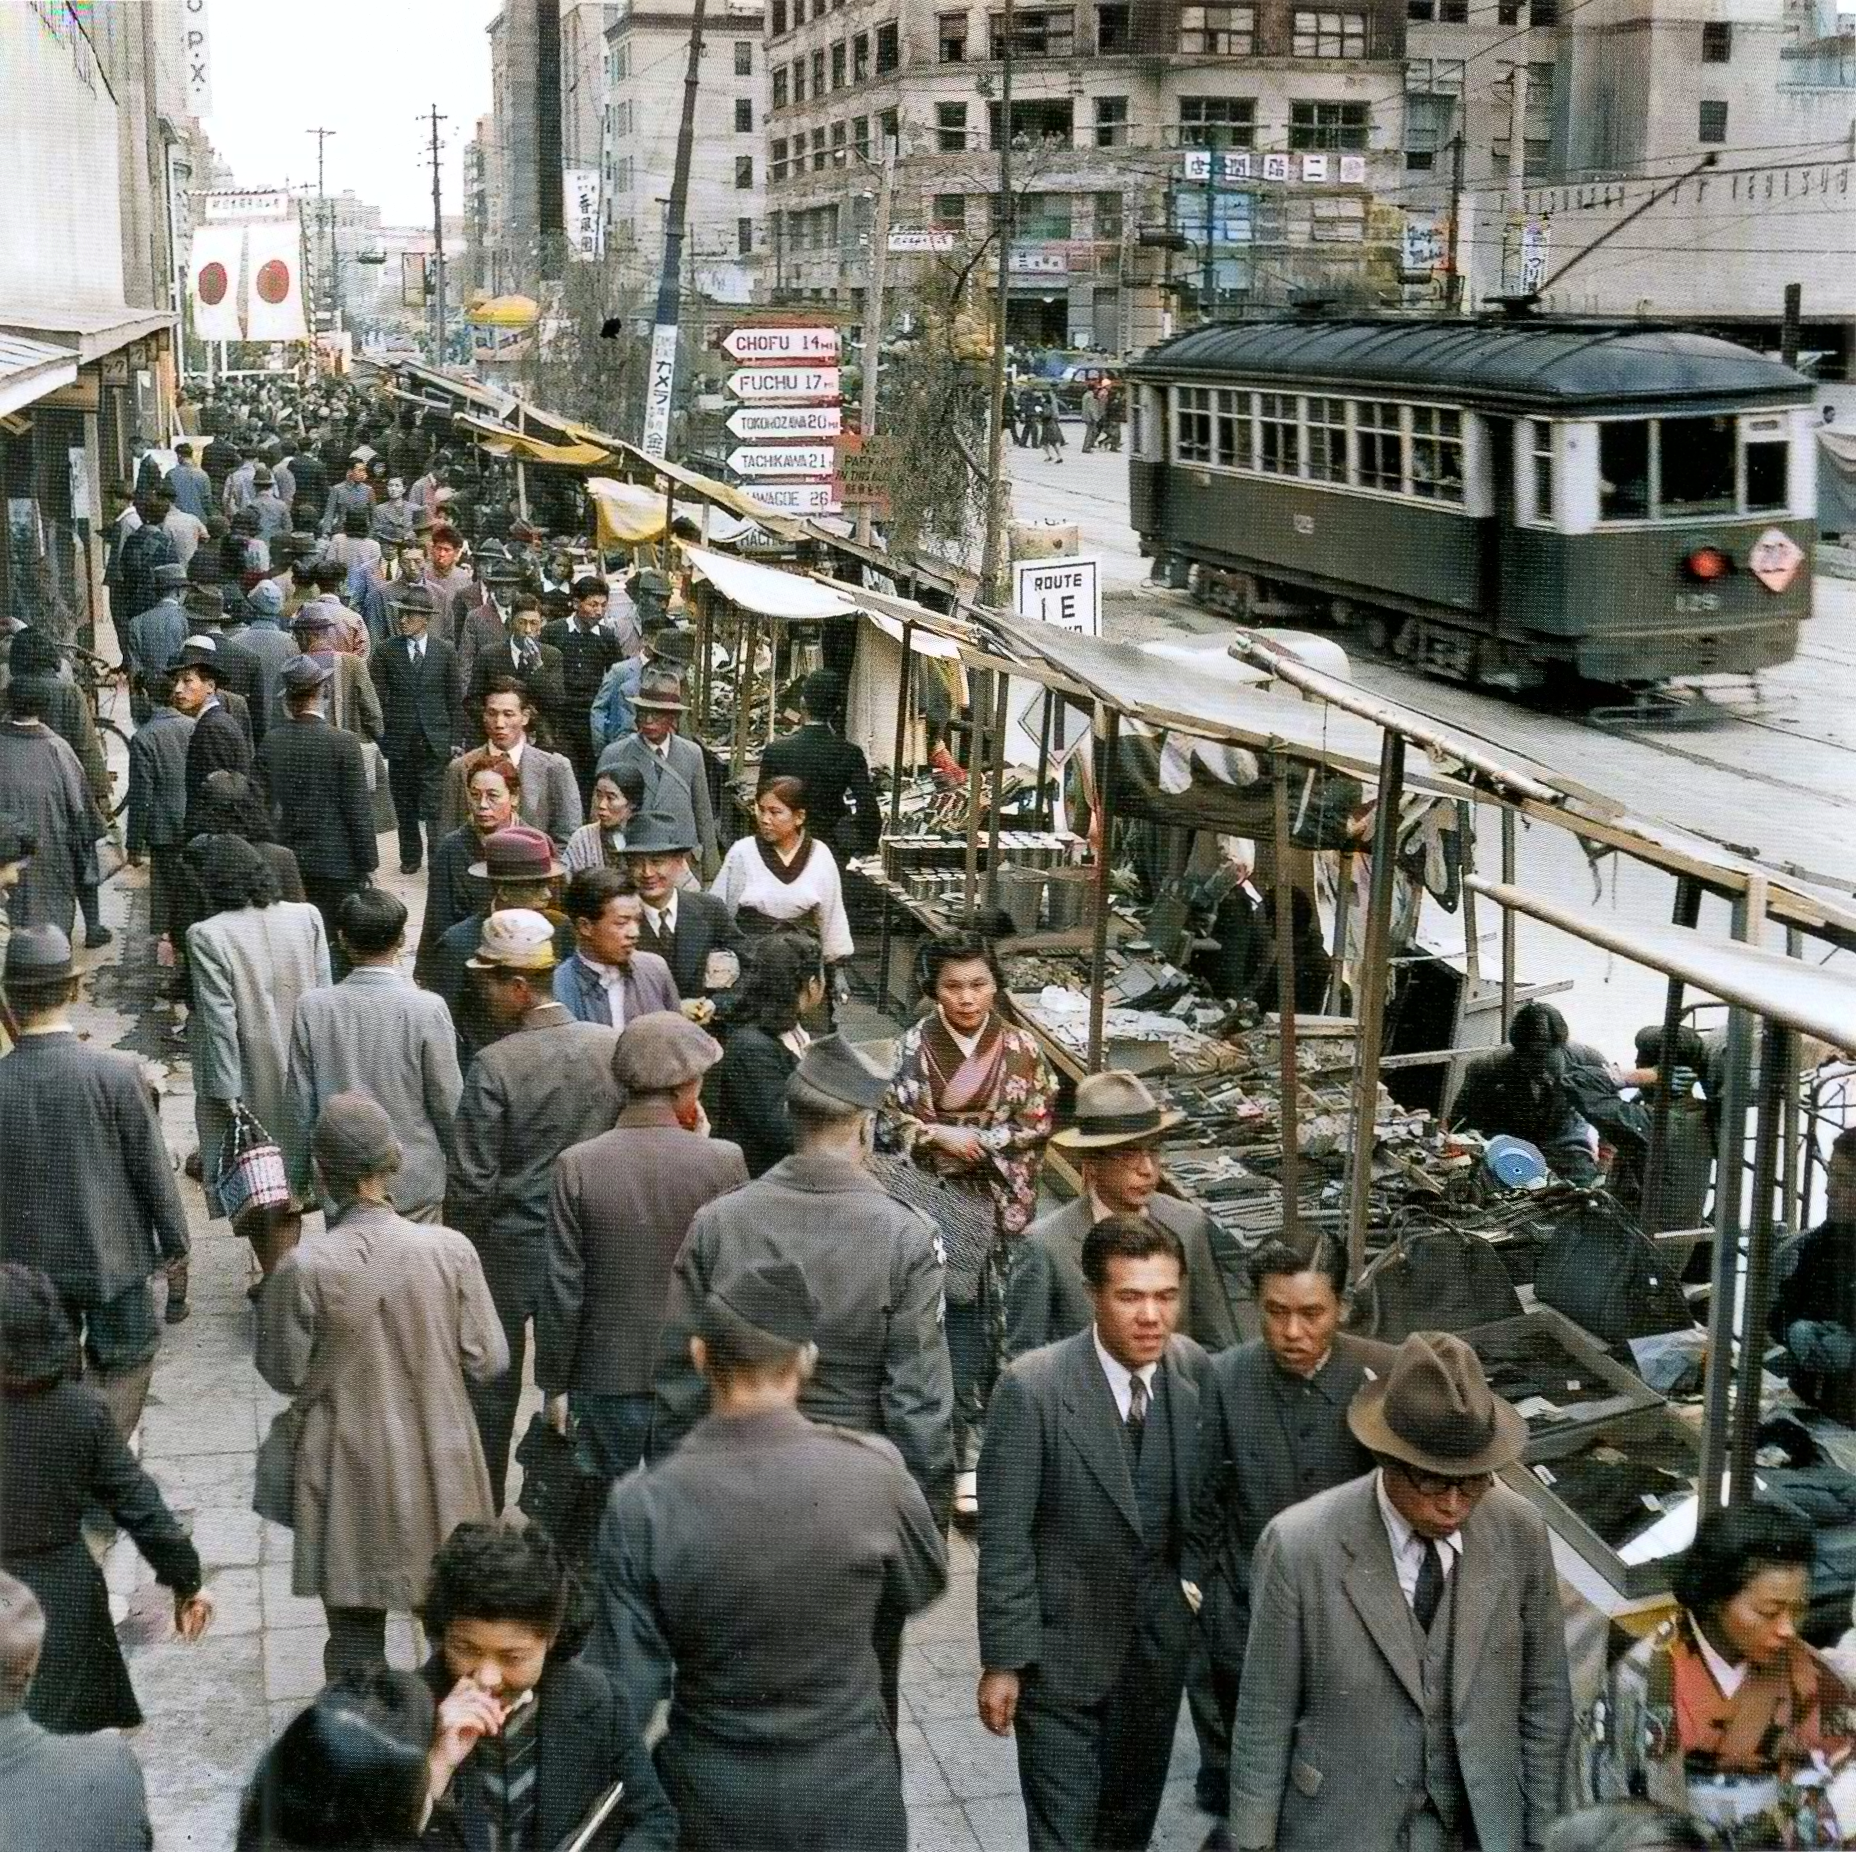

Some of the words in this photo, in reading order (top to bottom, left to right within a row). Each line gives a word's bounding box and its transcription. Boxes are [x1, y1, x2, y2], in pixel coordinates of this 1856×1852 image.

[736, 336, 790, 351] CHOFU
[803, 335, 819, 349] 14
[653, 360, 671, 405] カメラ
[740, 376, 797, 391] FUCHU
[805, 375, 822, 389] 17
[808, 414, 827, 429] 20
[741, 454, 806, 468] TACHIKAWA
[809, 454, 825, 468] 21
[810, 491, 828, 506] 26
[1034, 573, 1082, 591] ROUTE
